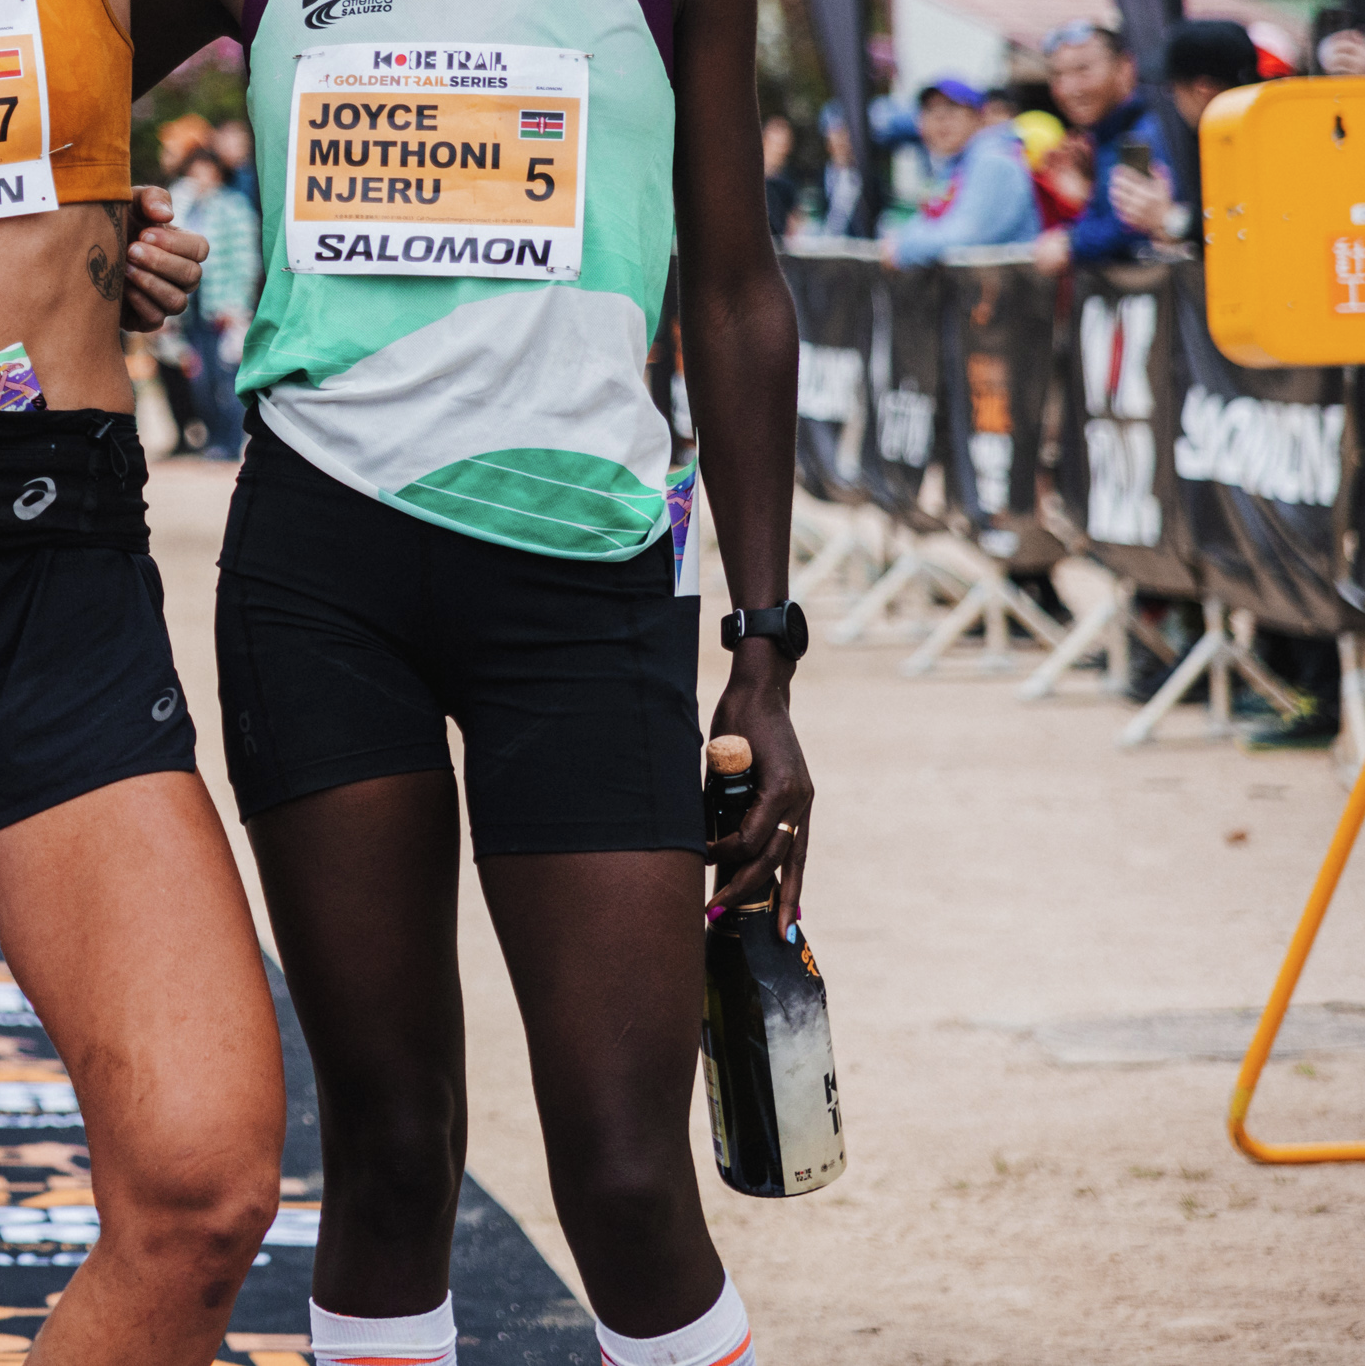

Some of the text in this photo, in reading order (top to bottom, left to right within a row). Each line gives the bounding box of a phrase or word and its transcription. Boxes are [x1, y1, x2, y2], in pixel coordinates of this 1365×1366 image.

[341, 4, 392, 17] SALUZZO
[443, 50, 507, 71] TRAIL
[308, 102, 439, 132] JOYCE
[308, 138, 501, 170] MUTHONI
[305, 175, 442, 206] NJERU
[524, 157, 555, 202] 5
[314, 234, 552, 267] SALOMON
